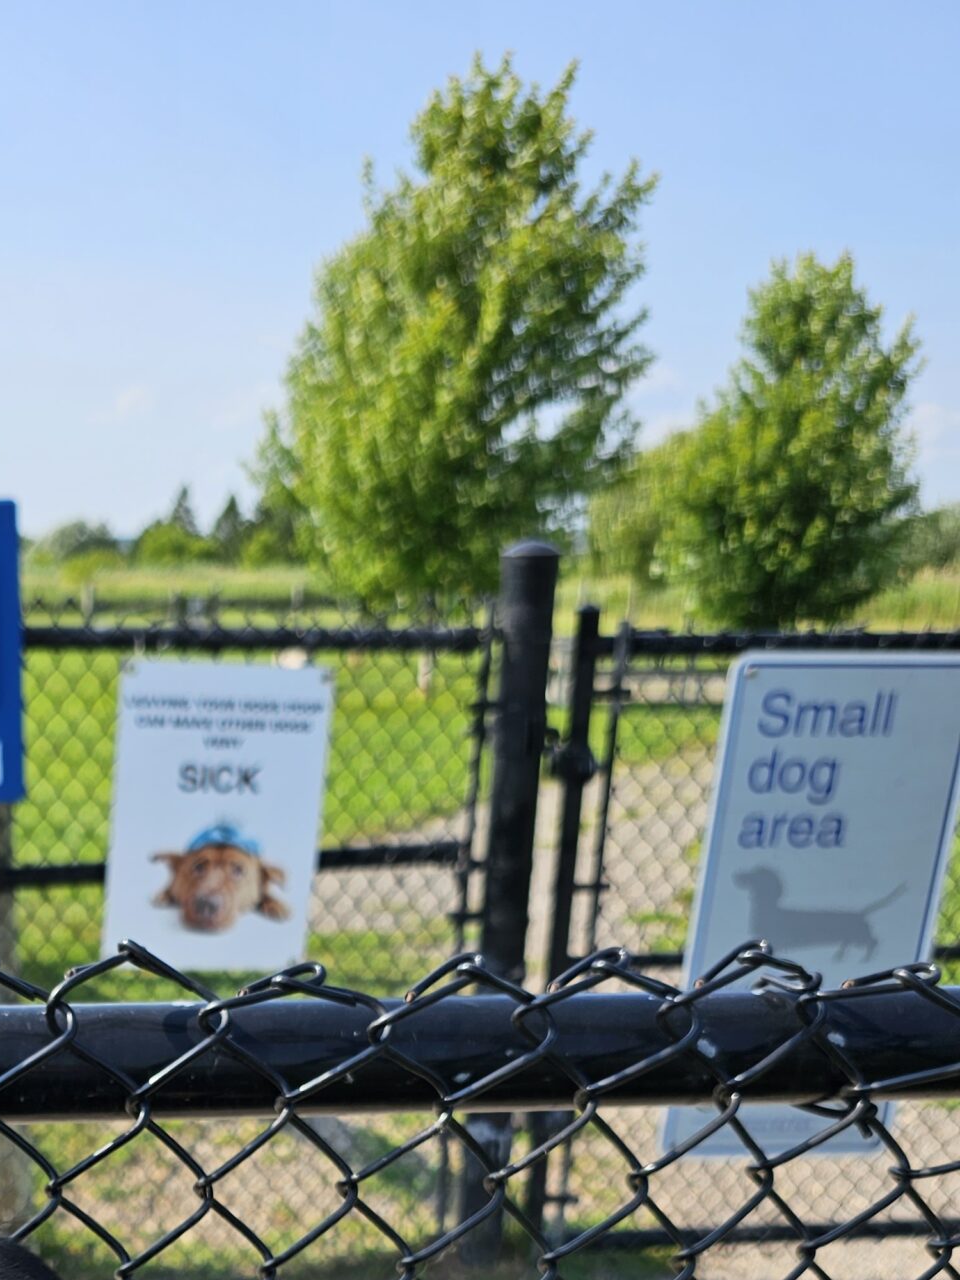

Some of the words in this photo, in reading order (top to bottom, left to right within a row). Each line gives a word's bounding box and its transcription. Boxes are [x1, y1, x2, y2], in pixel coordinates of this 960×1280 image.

[757, 688, 897, 738] Small
[178, 763, 262, 795] SICK
[747, 746, 839, 805] dog
[738, 812, 847, 850] area
